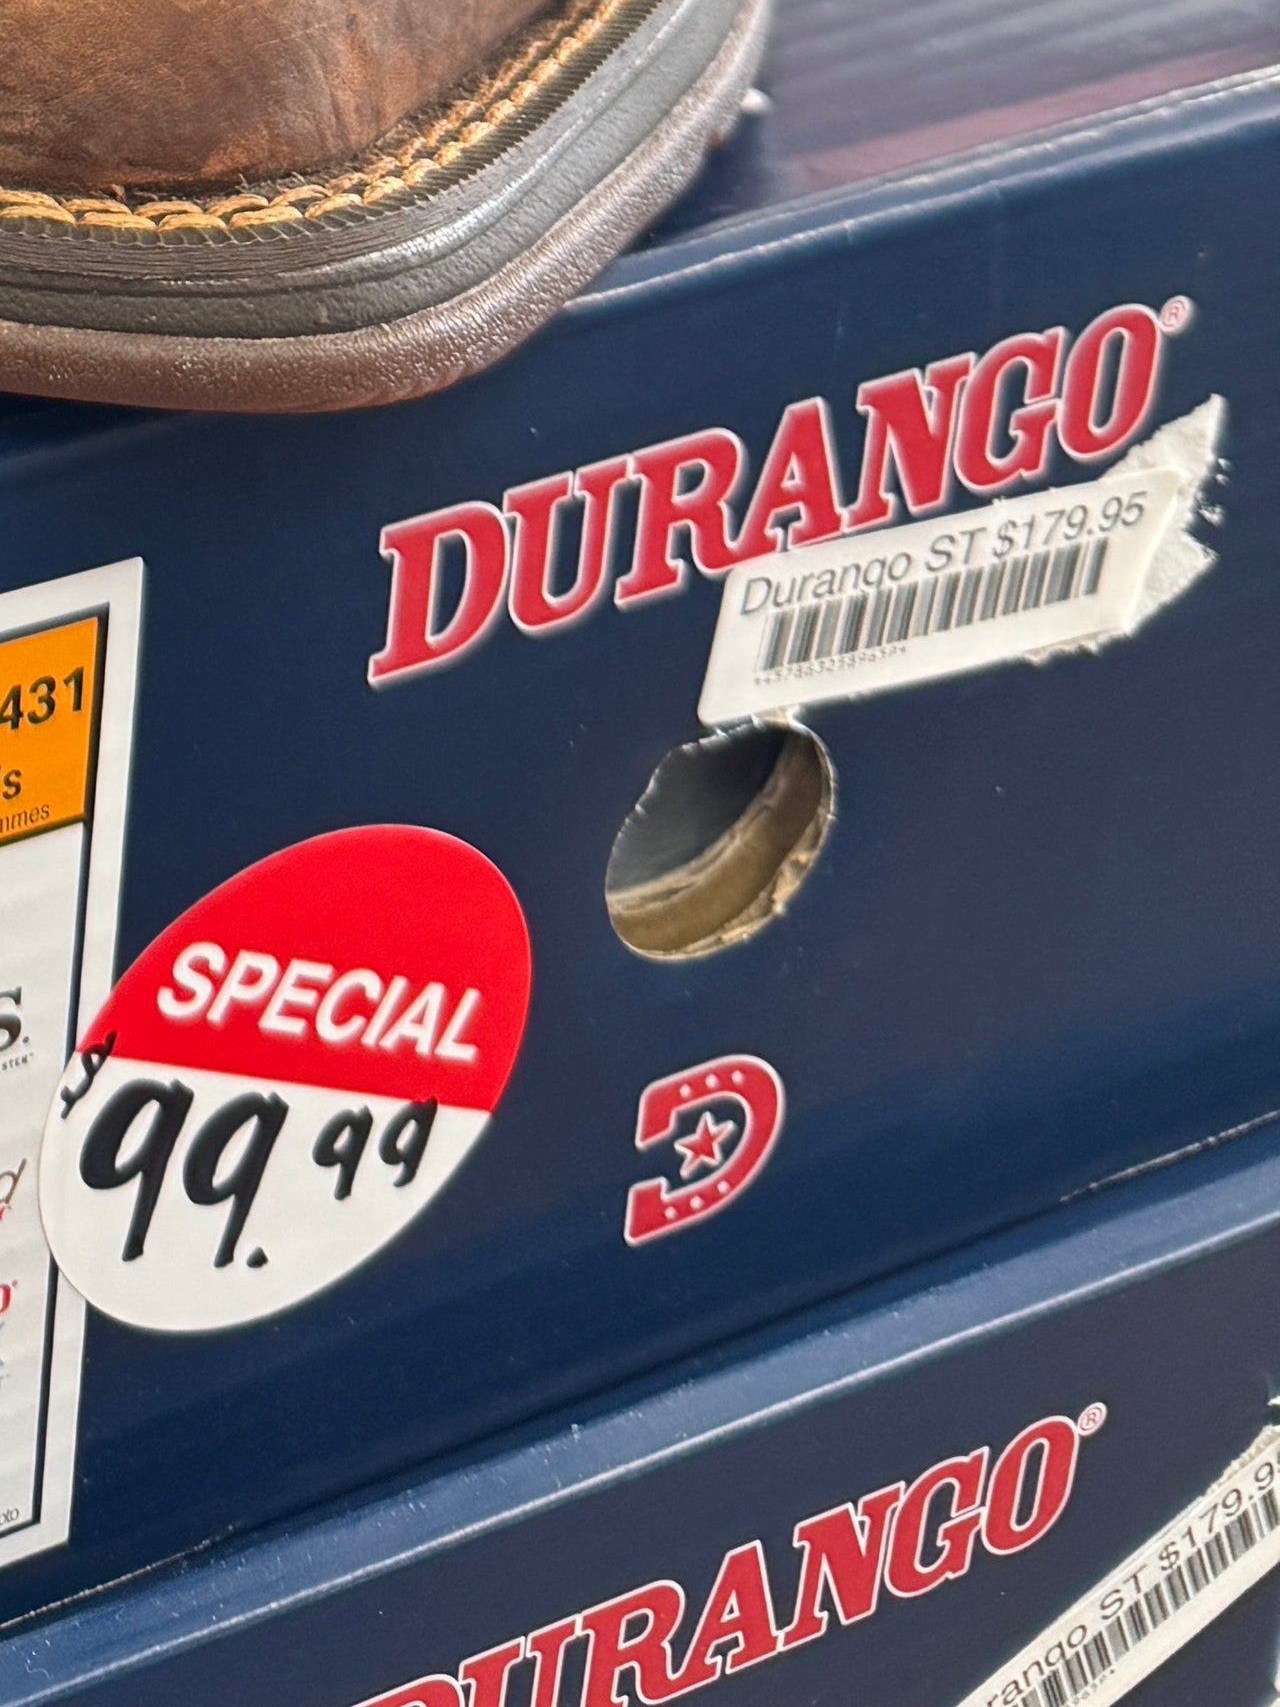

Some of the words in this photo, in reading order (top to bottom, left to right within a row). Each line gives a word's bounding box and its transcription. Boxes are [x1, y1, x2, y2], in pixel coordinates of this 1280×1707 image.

[739, 551, 913, 617] Durango
[924, 529, 989, 573] ST
[990, 491, 1150, 562] $179.95
[155, 940, 483, 1064] SPECIAL
[1098, 1563, 1148, 1621] ST
[1158, 1453, 1280, 1573] $179.9
